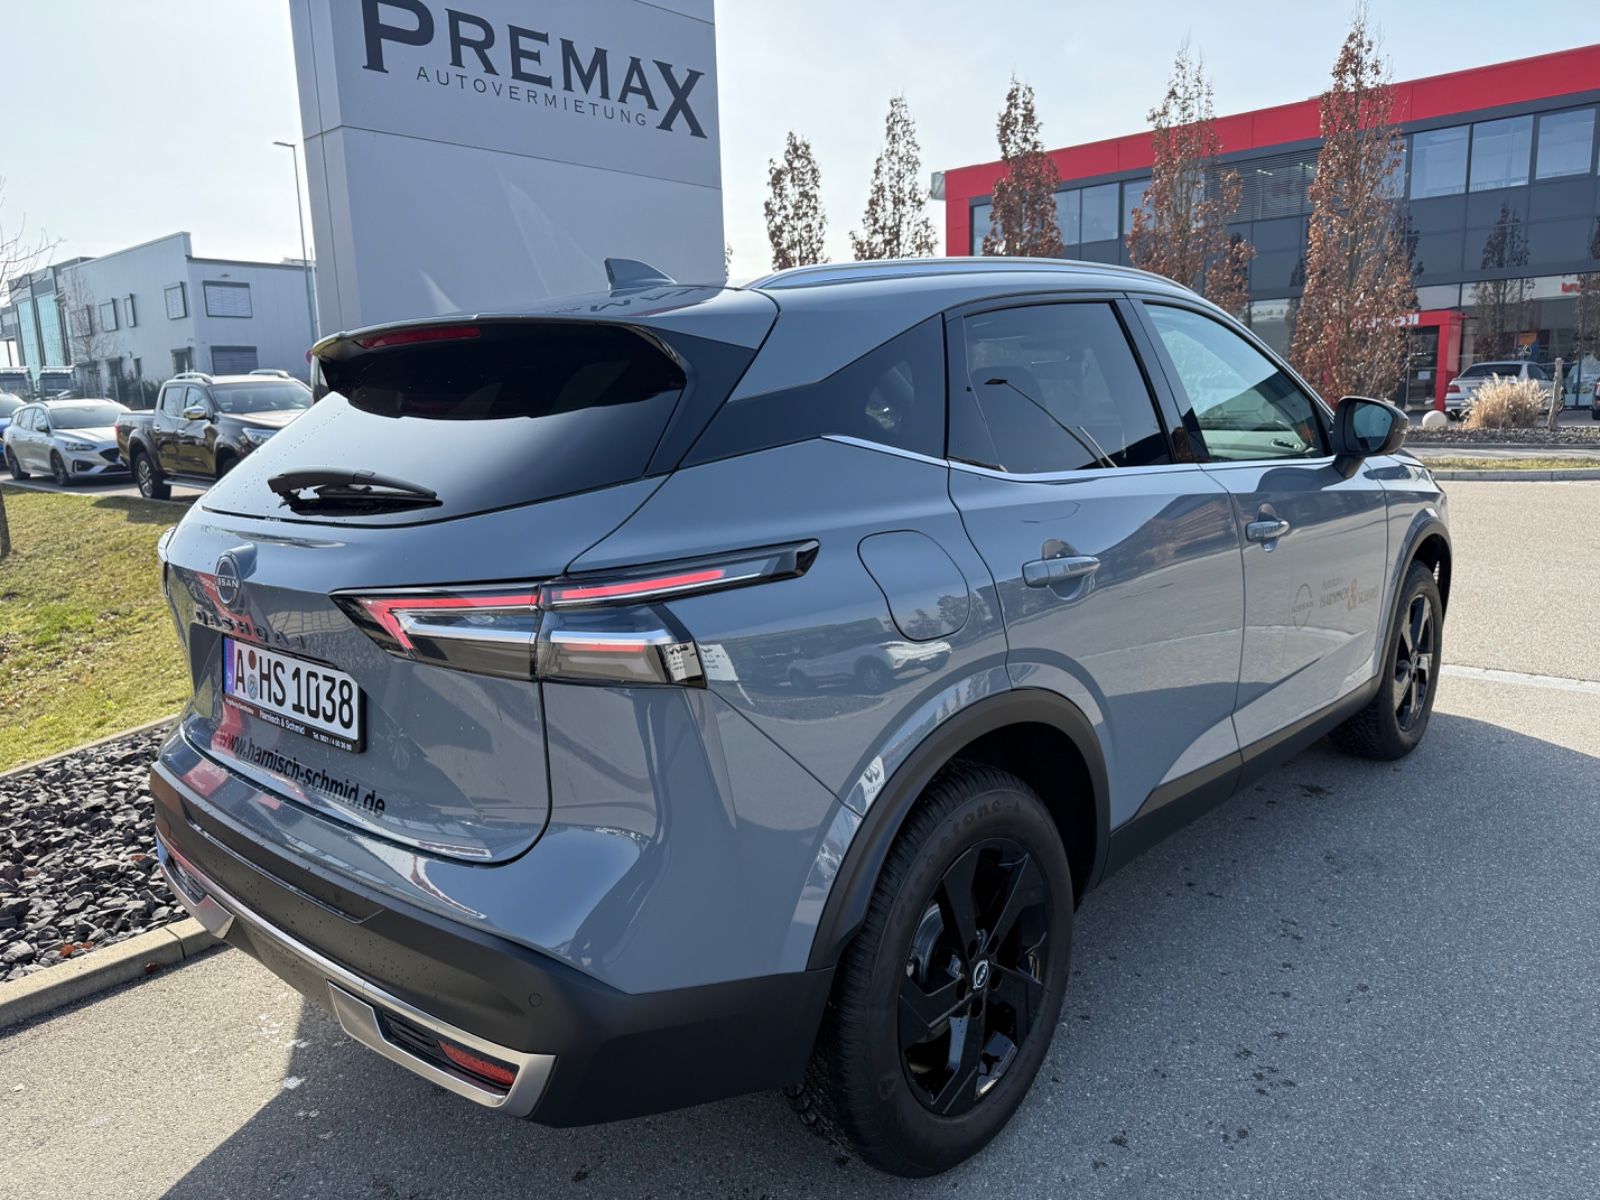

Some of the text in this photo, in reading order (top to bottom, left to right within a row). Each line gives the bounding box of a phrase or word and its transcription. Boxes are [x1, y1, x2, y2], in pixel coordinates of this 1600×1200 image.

[362, 0, 708, 139] PREMAX
[416, 66, 647, 127] AUTOVERMIETUNG
[235, 649, 354, 729] A HS 1038
